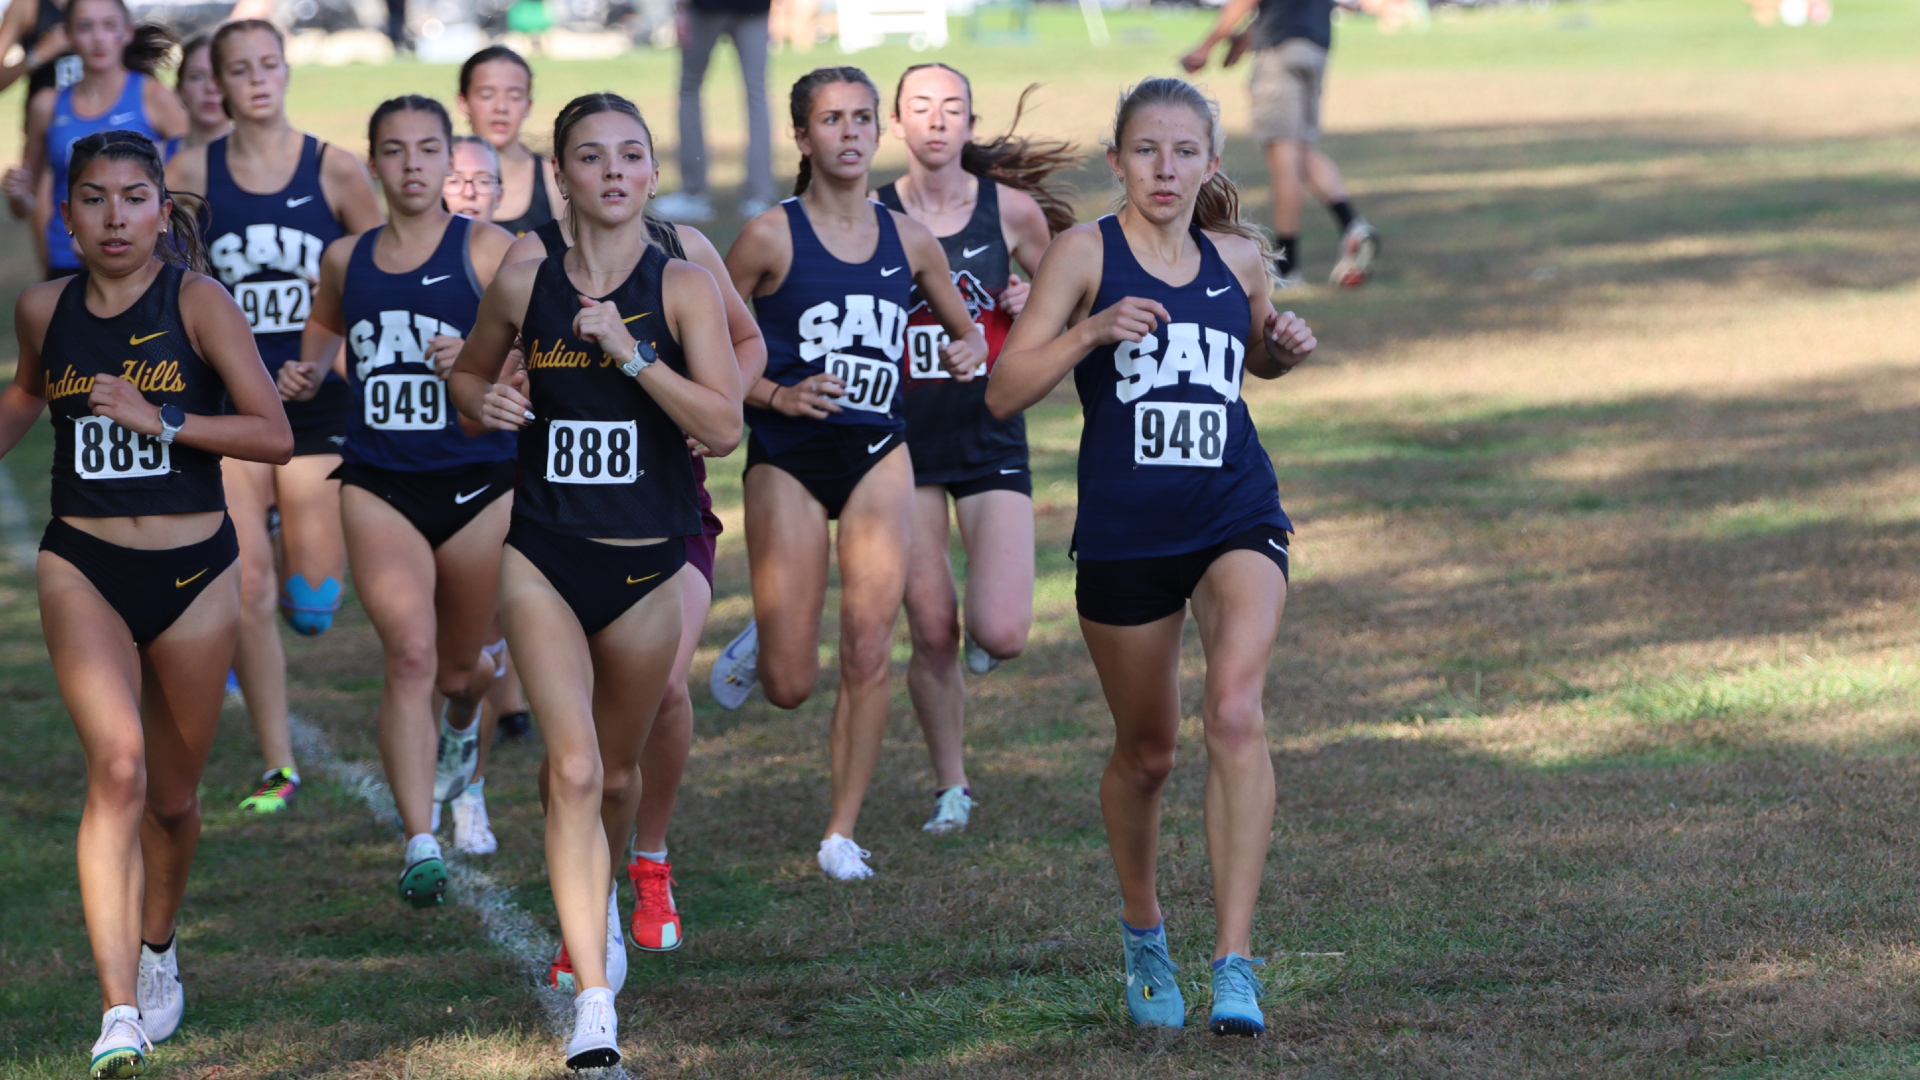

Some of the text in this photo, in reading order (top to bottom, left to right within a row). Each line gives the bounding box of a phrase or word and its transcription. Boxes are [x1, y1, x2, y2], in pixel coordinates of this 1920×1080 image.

[243, 286, 304, 326] 942
[798, 294, 908, 362] SAU
[119, 359, 186, 392] Hills
[528, 338, 591, 370] Indian
[1114, 323, 1245, 404] SAU
[371, 380, 439, 424] 949
[81, 421, 163, 473] 885
[554, 426, 631, 478] 888
[1141, 408, 1221, 460] 948
